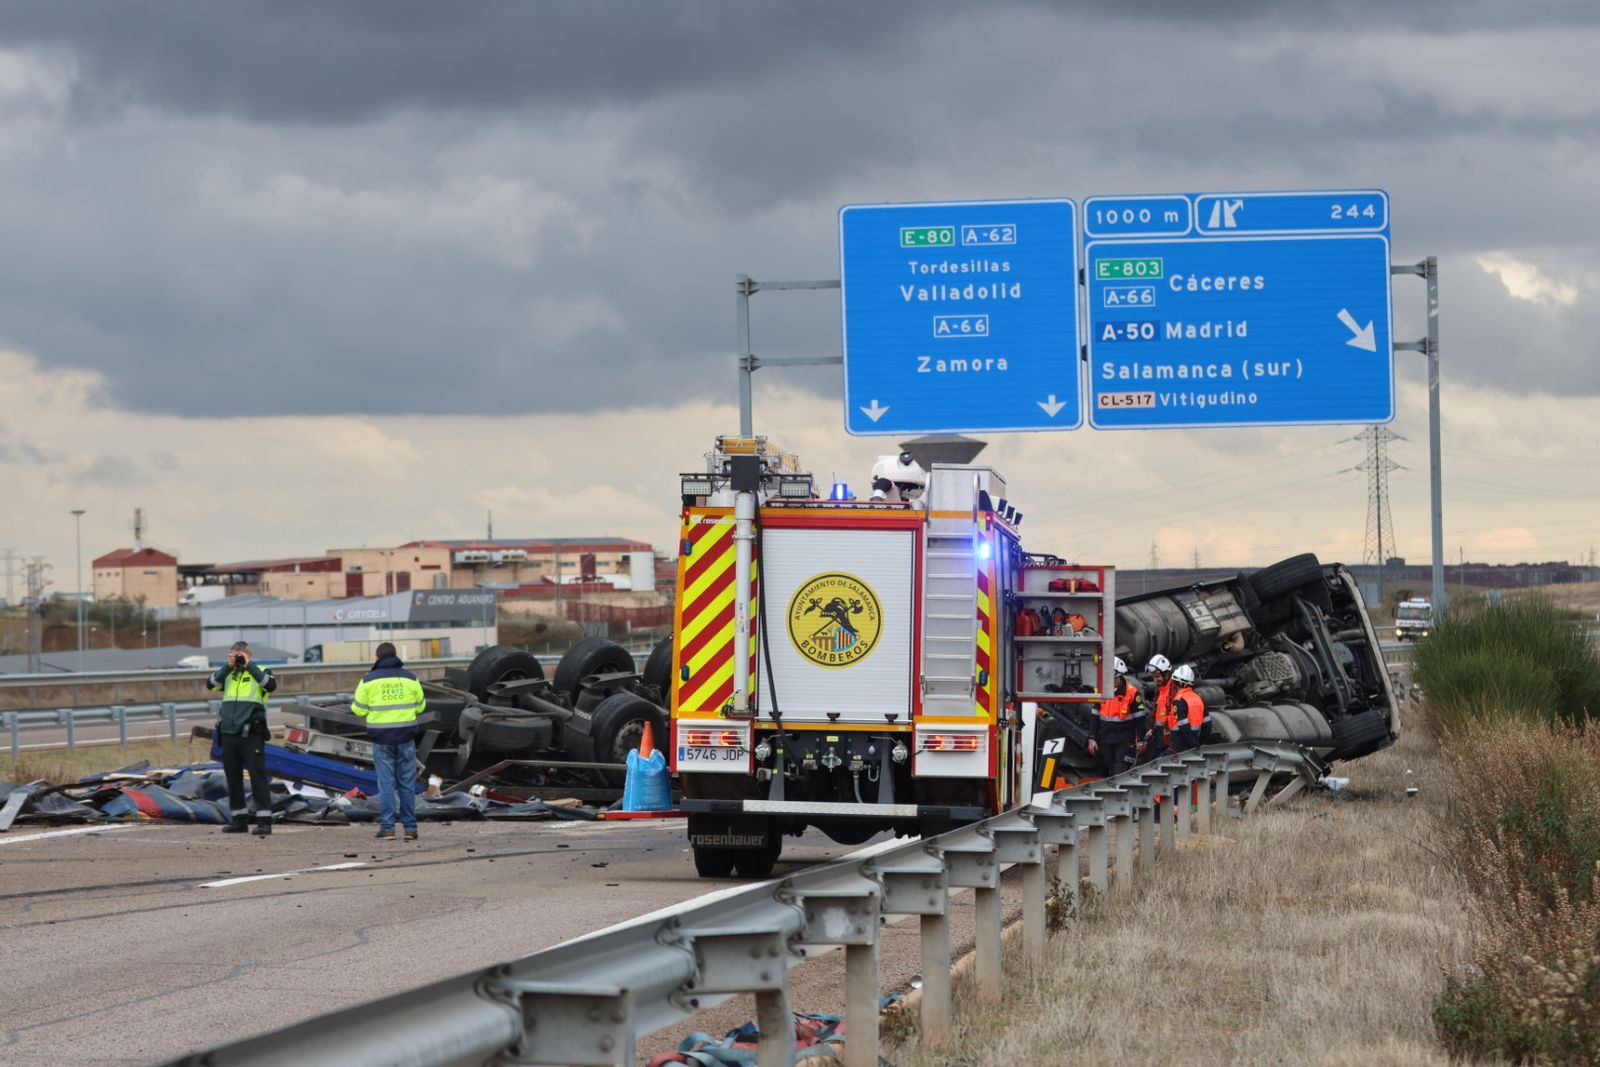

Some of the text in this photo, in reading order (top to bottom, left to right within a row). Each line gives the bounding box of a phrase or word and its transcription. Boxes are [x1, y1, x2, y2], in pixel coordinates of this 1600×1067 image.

[1096, 209, 1179, 225] 1000 m
[1331, 204, 1376, 220] 244
[904, 230, 952, 245] E-80
[965, 228, 1013, 243] A-62
[908, 260, 1011, 275] Tordesillas
[1099, 261, 1160, 277] E-803
[1169, 273, 1265, 292] Cáceres
[900, 282, 1022, 302] Valladolid
[1106, 289, 1153, 305] A-66
[937, 319, 986, 334] A-66
[1102, 320, 1248, 340] A-50 Madrid
[917, 356, 1008, 373] Zamora
[1101, 358, 1304, 381] Salamanca (sur)
[1100, 391, 1258, 409] CL-517 Vitigudino
[428, 594, 455, 605] CENTRO
[794, 580, 836, 621] AYUNTAMIENTO
[847, 581, 876, 621] SALAMANCA
[800, 639, 869, 662] BOMBEROS
[686, 749, 744, 760] 5746 JDP
[1050, 740, 1059, 753] 7
[690, 826, 765, 846] rosenbauer
